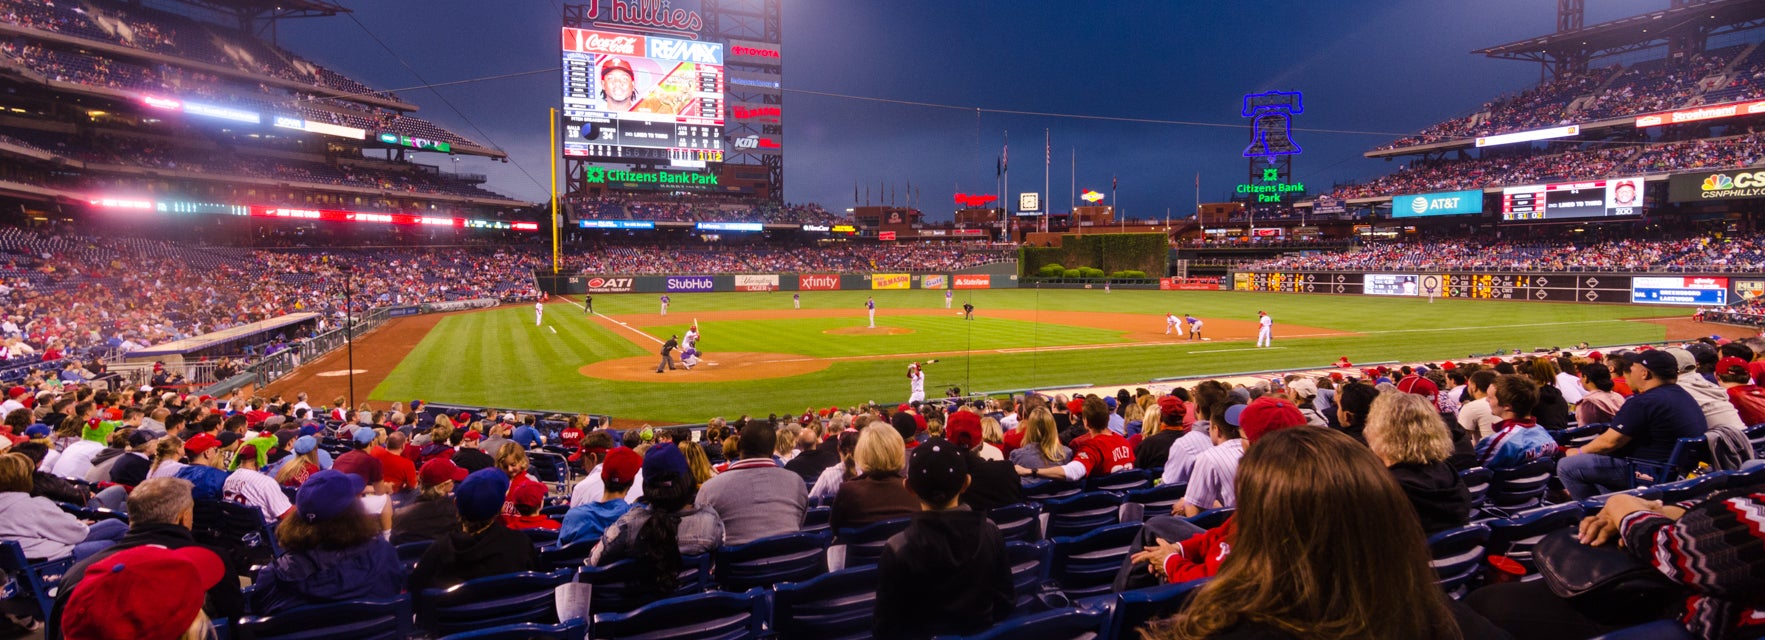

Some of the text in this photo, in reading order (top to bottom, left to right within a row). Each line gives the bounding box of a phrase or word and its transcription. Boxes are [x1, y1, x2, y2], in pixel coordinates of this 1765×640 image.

[651, 39, 717, 63] RE/MAX
[744, 47, 780, 58] TOYOTA
[1672, 105, 1737, 122] Stroehmann
[602, 132, 613, 140] 34
[607, 169, 718, 184] Citizens Bank Park
[1237, 182, 1304, 193] Citizens Bank
[1259, 193, 1280, 202] Park
[1430, 198, 1460, 210] AT&T
[604, 278, 633, 287] ATI
[667, 278, 713, 289] StubHub
[802, 277, 838, 289] xfinity
[926, 278, 943, 286] Gulf
[1112, 445, 1130, 462] UTLEY
